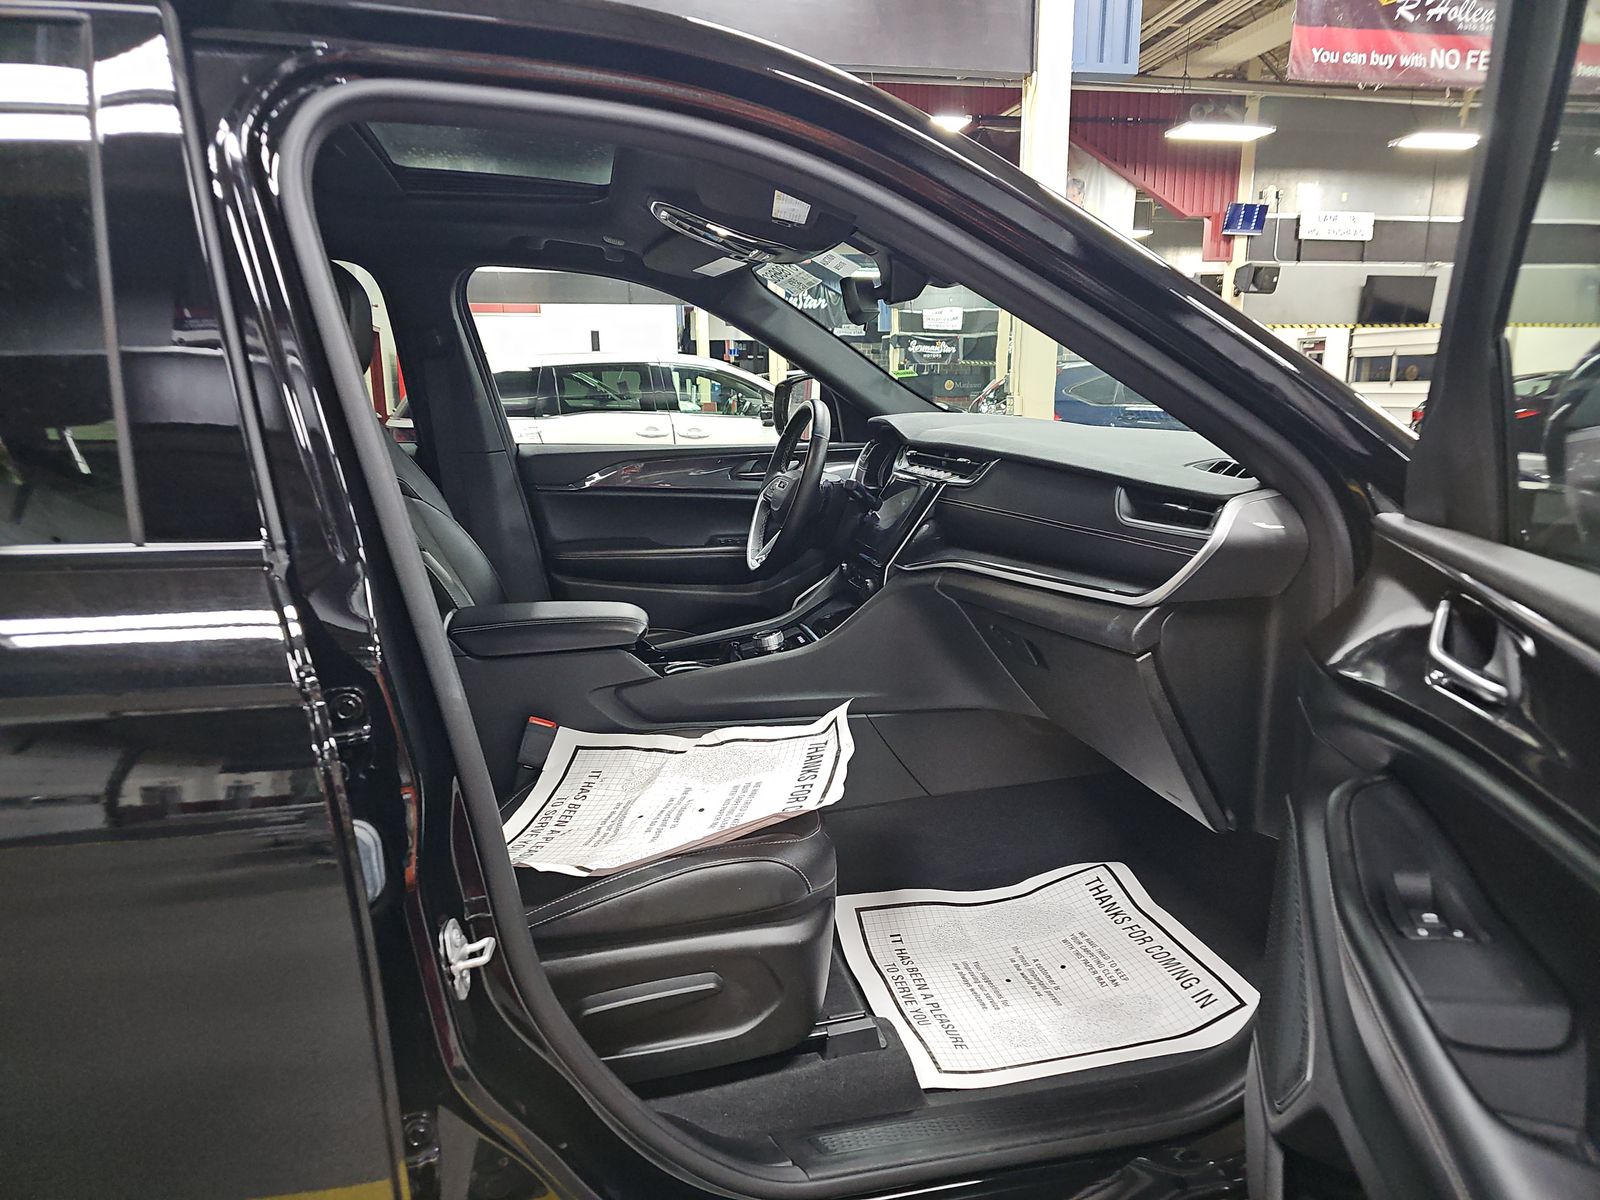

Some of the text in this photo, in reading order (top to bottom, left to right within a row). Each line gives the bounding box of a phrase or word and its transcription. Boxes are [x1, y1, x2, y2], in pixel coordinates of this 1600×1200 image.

[1425, 0, 1496, 22] Hollen
[1311, 47, 1491, 71] You can buy with NO FE
[797, 740, 829, 782] THANKS
[588, 770, 603, 779] IT
[551, 796, 570, 808] TO
[573, 781, 596, 801] HAS
[786, 783, 814, 804] FOR
[524, 810, 558, 838] SERVE
[554, 803, 582, 827] BEEN
[889, 933, 904, 945] IT
[1085, 876, 1218, 1009] THANKS FOR COMING IN
[894, 948, 915, 966] HAS
[1061, 938, 1109, 988] WITH THIS PAPER MAT
[1070, 933, 1121, 988] YOUR CARPETING CLEAN
[1078, 931, 1130, 981] WE HAVE TRIED TO KEEP
[906, 966, 930, 991] BEEN
[957, 971, 973, 988] always
[1035, 963, 1057, 985] customer
[884, 962, 932, 1027] TO SERVE YOU
[983, 992, 1001, 1010] service
[1044, 990, 1063, 1007] person
[925, 1002, 969, 1050] PLEASURE
